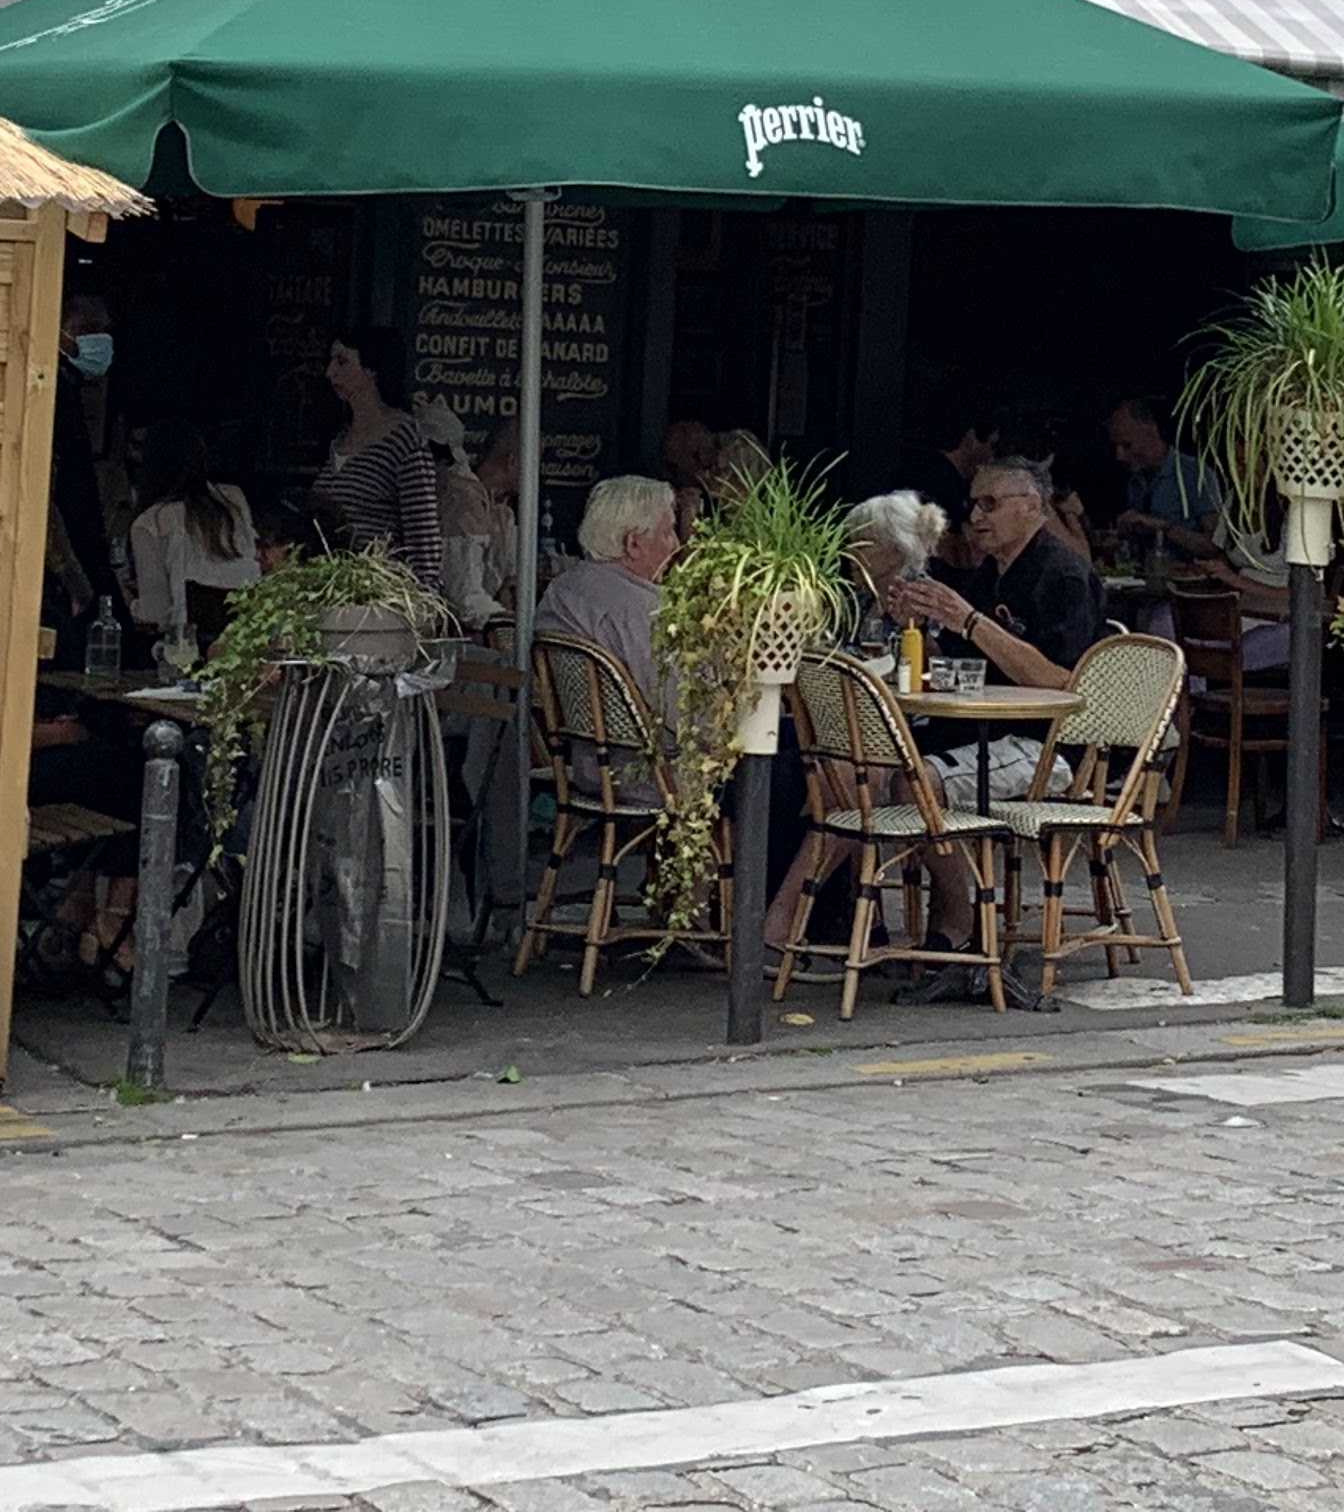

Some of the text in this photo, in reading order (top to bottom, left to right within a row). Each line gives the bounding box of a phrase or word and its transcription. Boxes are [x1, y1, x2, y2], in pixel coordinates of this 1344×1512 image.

[422, 217, 525, 245] OMELETTES
[418, 275, 584, 307] HAMBURERS
[414, 332, 610, 365] CONFIT DE ANARD
